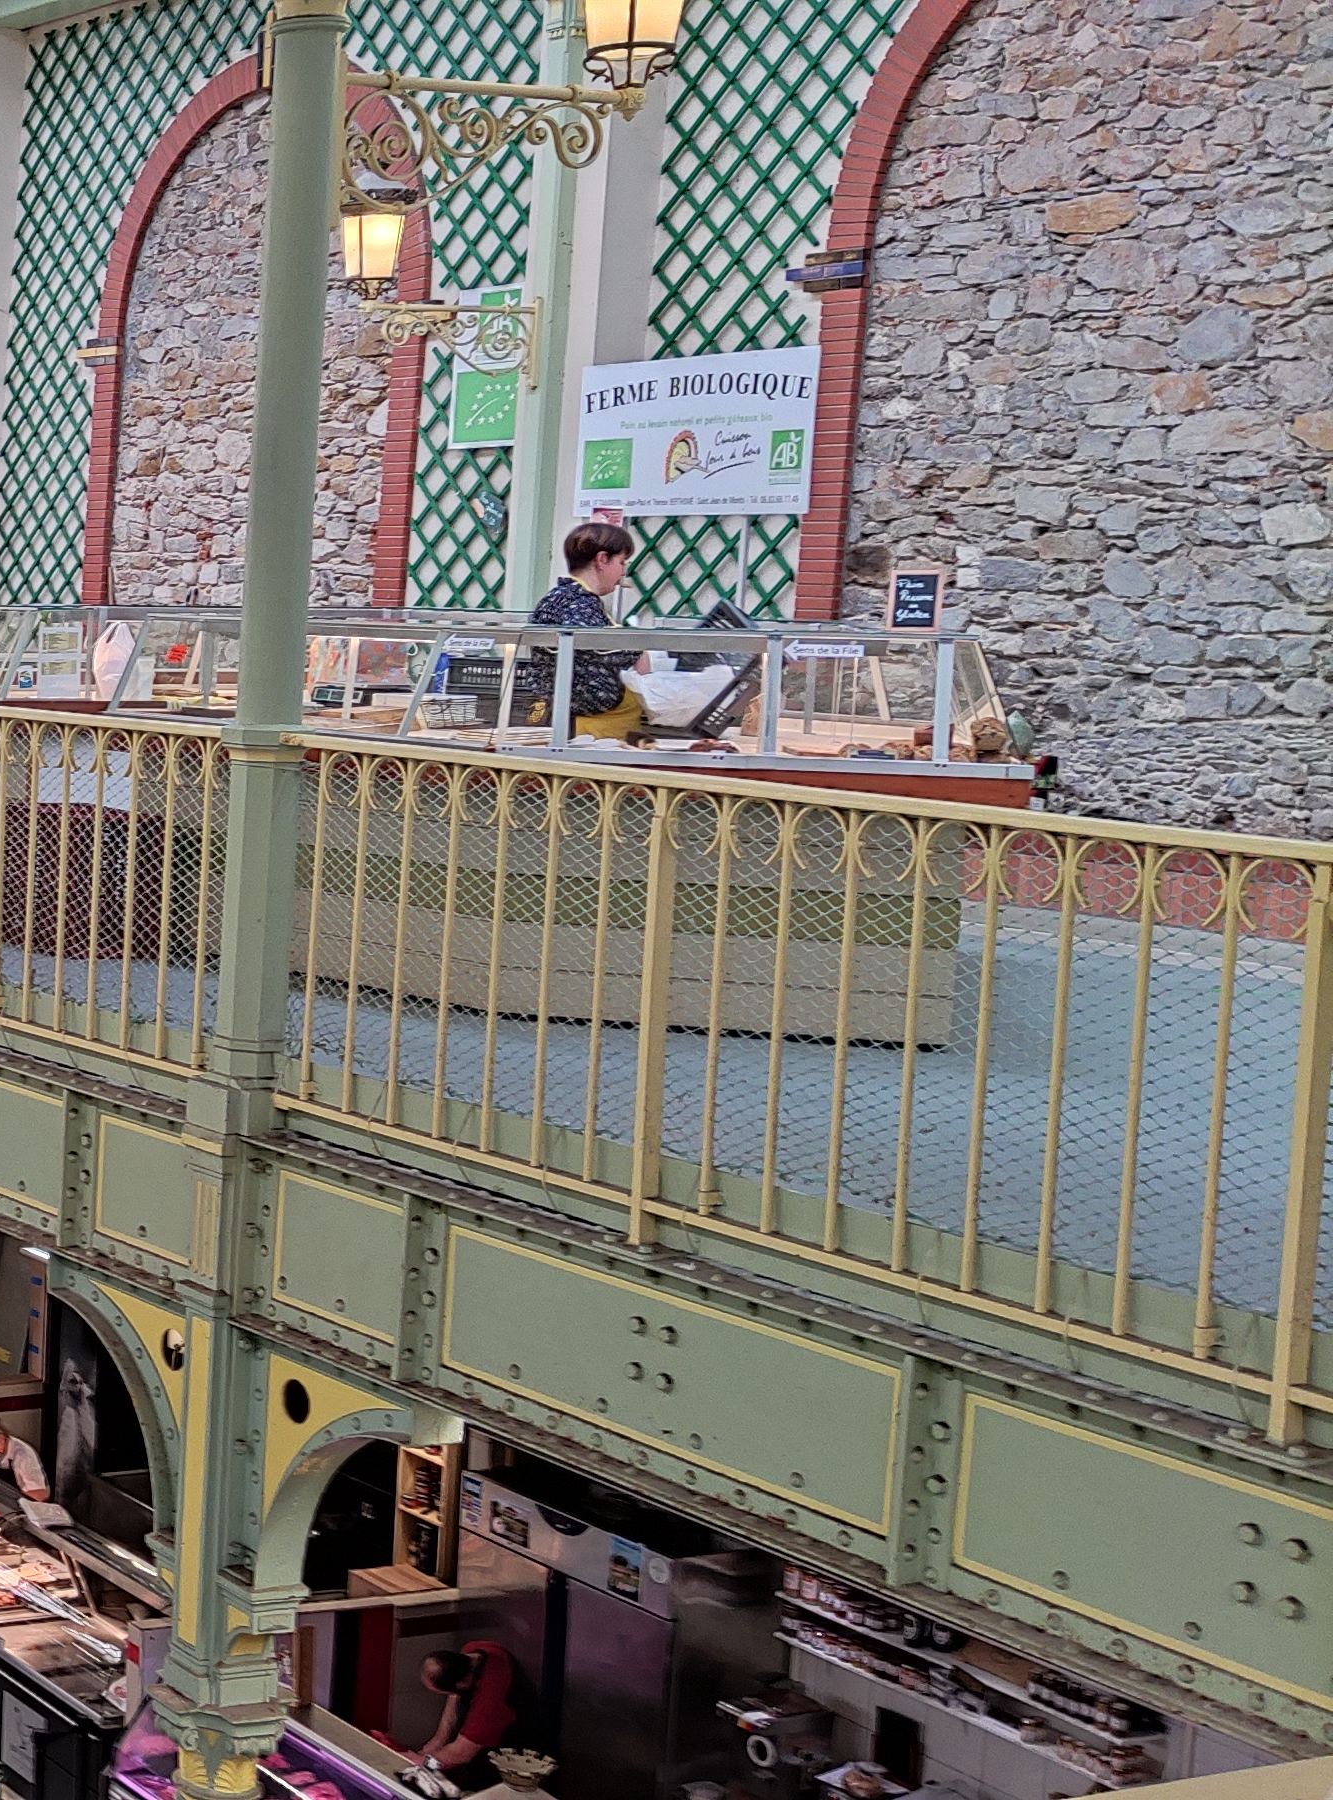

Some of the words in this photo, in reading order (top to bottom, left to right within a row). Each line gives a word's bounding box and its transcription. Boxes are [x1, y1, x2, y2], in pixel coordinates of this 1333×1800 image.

[585, 379, 658, 414] FERME
[668, 372, 813, 400] BIOLOGIQUE
[669, 416, 694, 427] naturel
[695, 417, 704, 426] et
[704, 415, 726, 426] petits
[727, 414, 758, 426] gâteaux
[760, 411, 774, 422] bio
[714, 430, 752, 447] Cuisson
[704, 450, 725, 474] four
[741, 442, 761, 459] bois
[771, 441, 799, 469] AB
[793, 646, 815, 654] Sens
[817, 645, 829, 655] de
[831, 645, 840, 655] la
[842, 645, 859, 655] File
